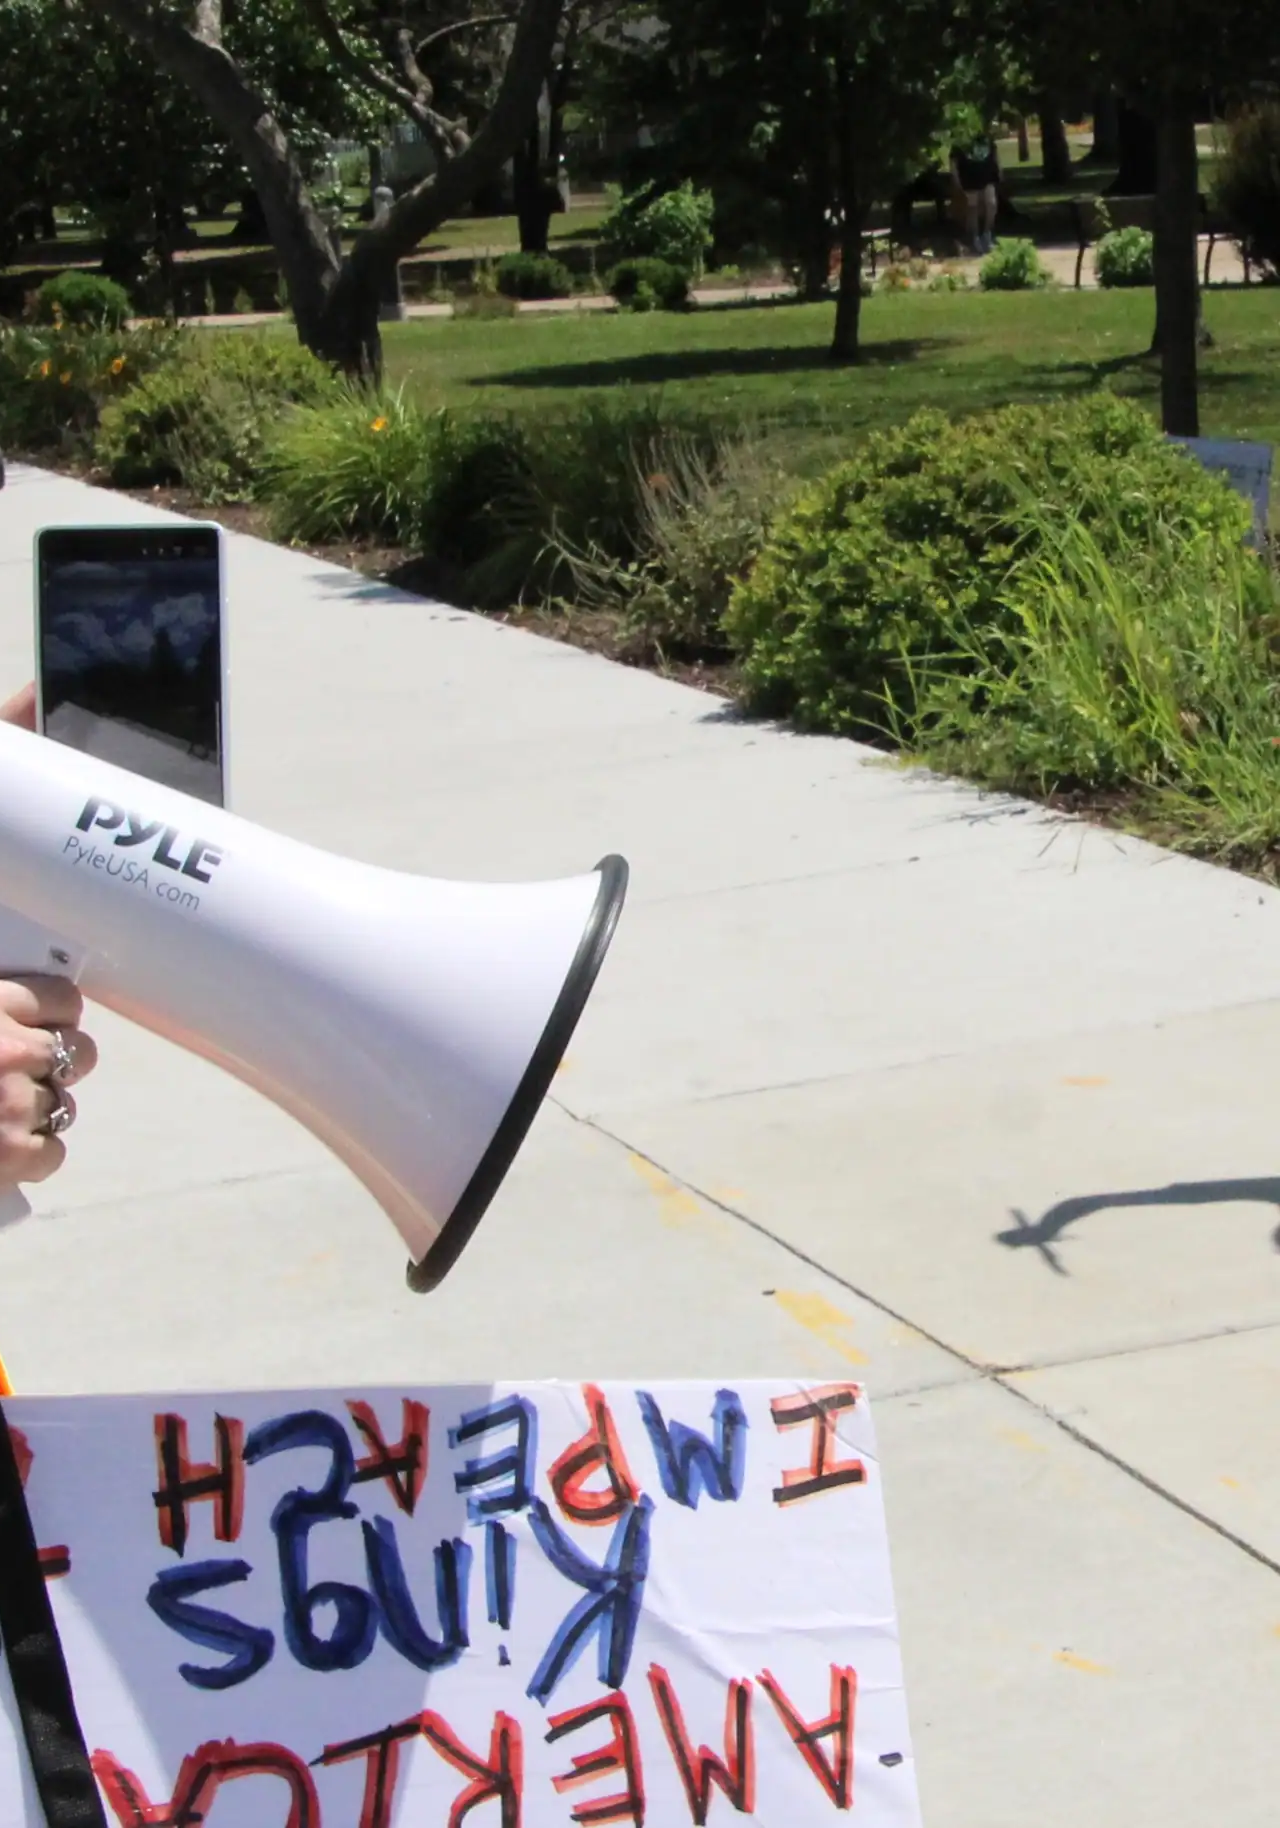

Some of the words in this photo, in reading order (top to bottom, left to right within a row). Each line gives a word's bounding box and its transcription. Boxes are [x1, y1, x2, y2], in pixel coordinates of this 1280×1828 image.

[62, 835, 202, 911] PyleUSA.com
[152, 1382, 867, 1557] IMPEACH
[147, 1490, 655, 1707] Kings
[91, 1662, 858, 1828] AMERICA
